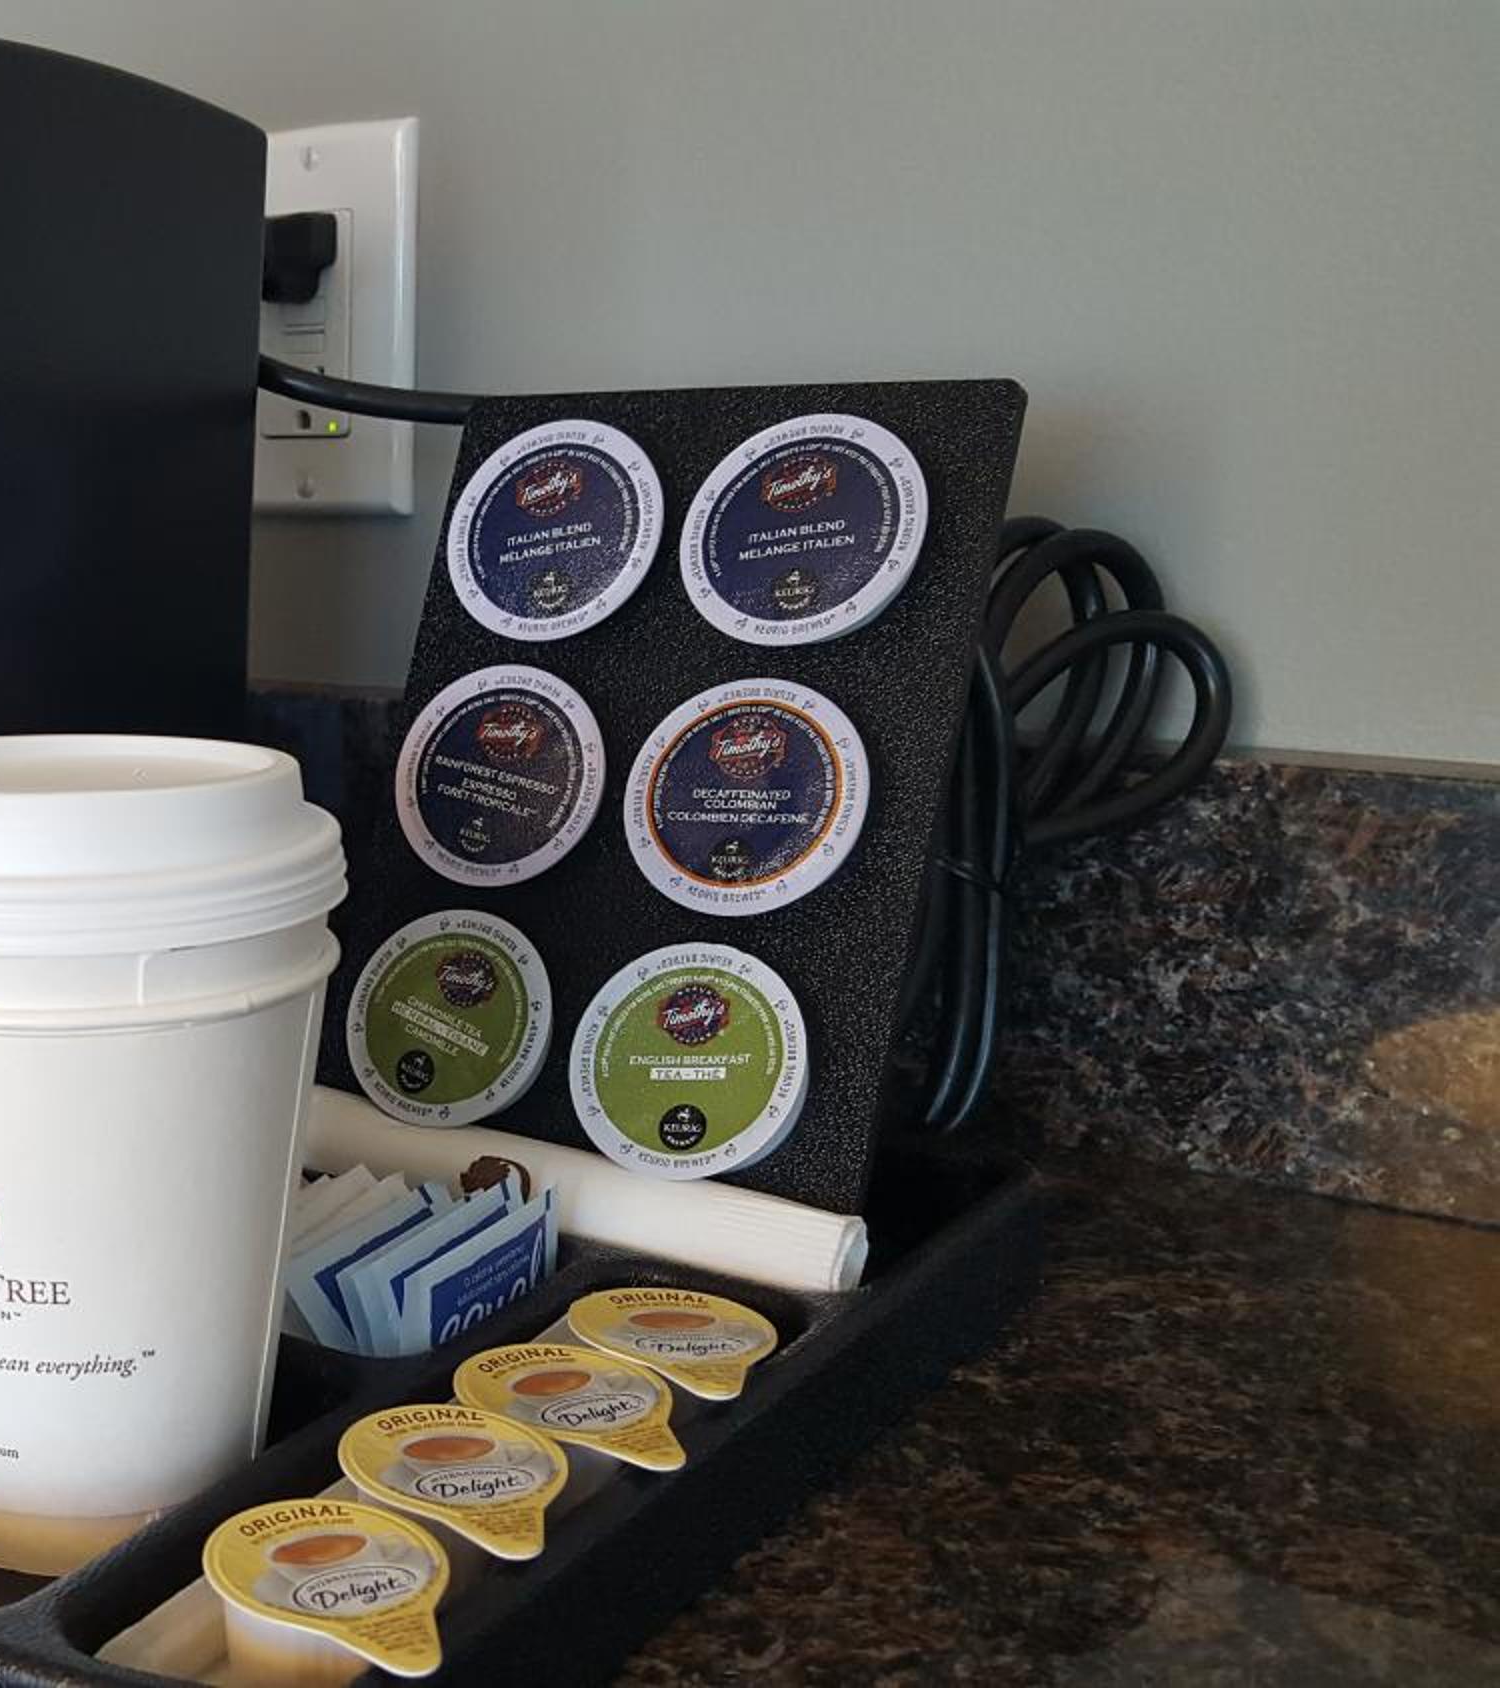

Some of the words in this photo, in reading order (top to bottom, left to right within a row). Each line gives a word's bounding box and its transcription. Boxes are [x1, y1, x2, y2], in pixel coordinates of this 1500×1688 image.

[765, 465, 833, 500] Timothy's
[507, 529, 550, 548] ITALIAN
[552, 521, 592, 539] BLEND
[748, 527, 797, 544] ITALIAN
[800, 519, 845, 535] BLEND
[803, 534, 855, 551] ITALIEN
[555, 535, 601, 553] ITALIEN
[714, 731, 781, 758] Timothy's
[436, 755, 498, 779] RAINFOREST
[693, 788, 791, 801] DECAFFEINATED
[704, 799, 777, 811] COLOMBIAN
[668, 811, 739, 823] COLOMBIEN
[663, 998, 725, 1028] Timothy's
[629, 1055, 680, 1066] ENGLISH
[683, 1053, 752, 1065] BREAKFAST
[655, 1069, 683, 1080] TEA
[608, 1292, 710, 1306] ORIGINAL
[478, 1347, 571, 1373] ORIGINAL
[656, 1342, 728, 1356] Delight
[377, 1409, 485, 1431] ORIGINAL
[557, 1400, 633, 1427] Delight
[431, 1475, 516, 1499] Delight
[238, 1504, 351, 1537] ORIGINAL
[311, 1576, 399, 1610] Delight
